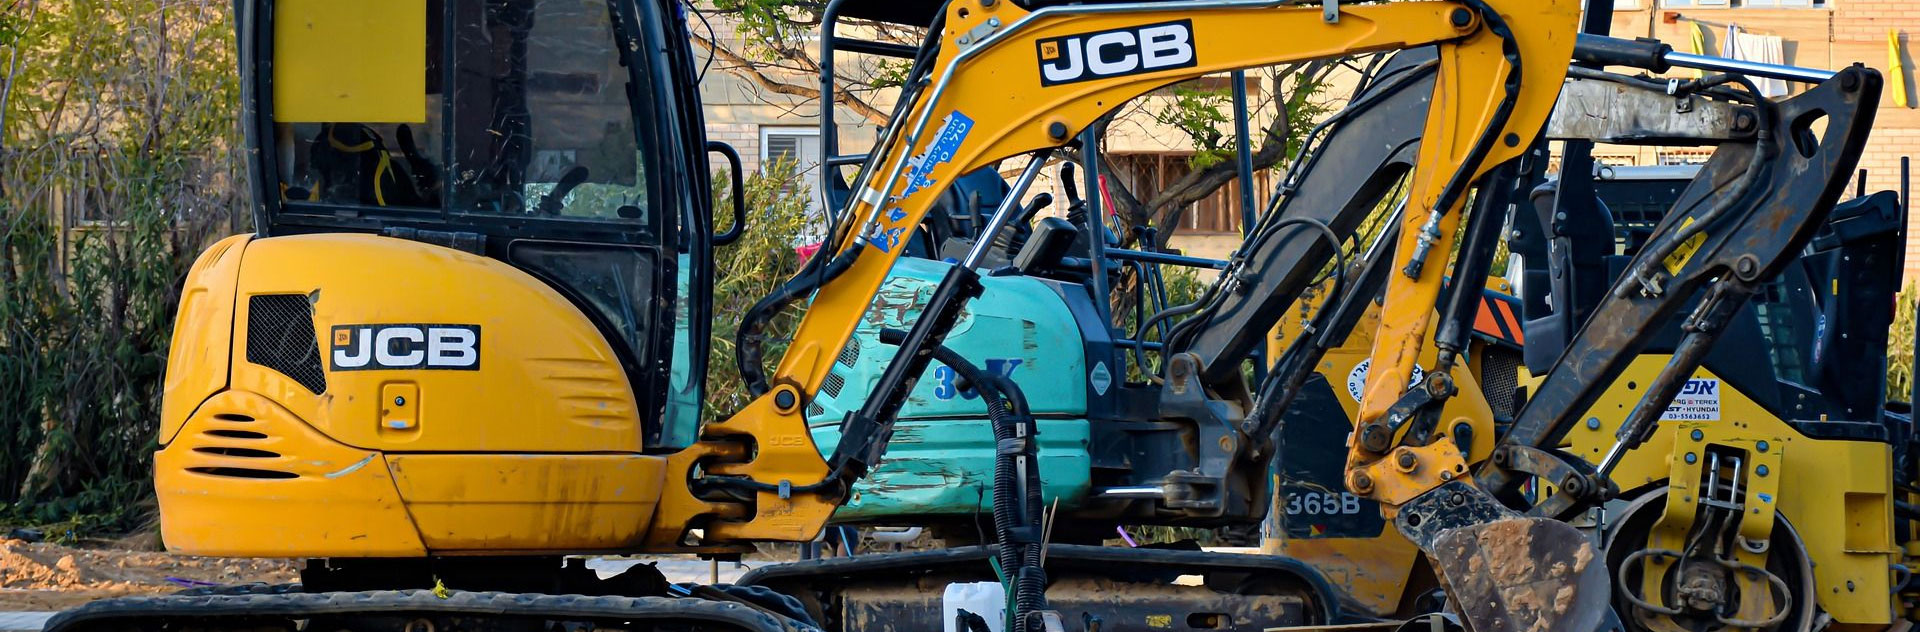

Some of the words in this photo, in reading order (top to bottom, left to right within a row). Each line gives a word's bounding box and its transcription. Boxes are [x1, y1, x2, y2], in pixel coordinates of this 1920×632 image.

[1043, 24, 1193, 81] JCB
[333, 327, 477, 367] JCB
[1682, 380, 1717, 395] אפ
[1286, 492, 1361, 515] 365B
